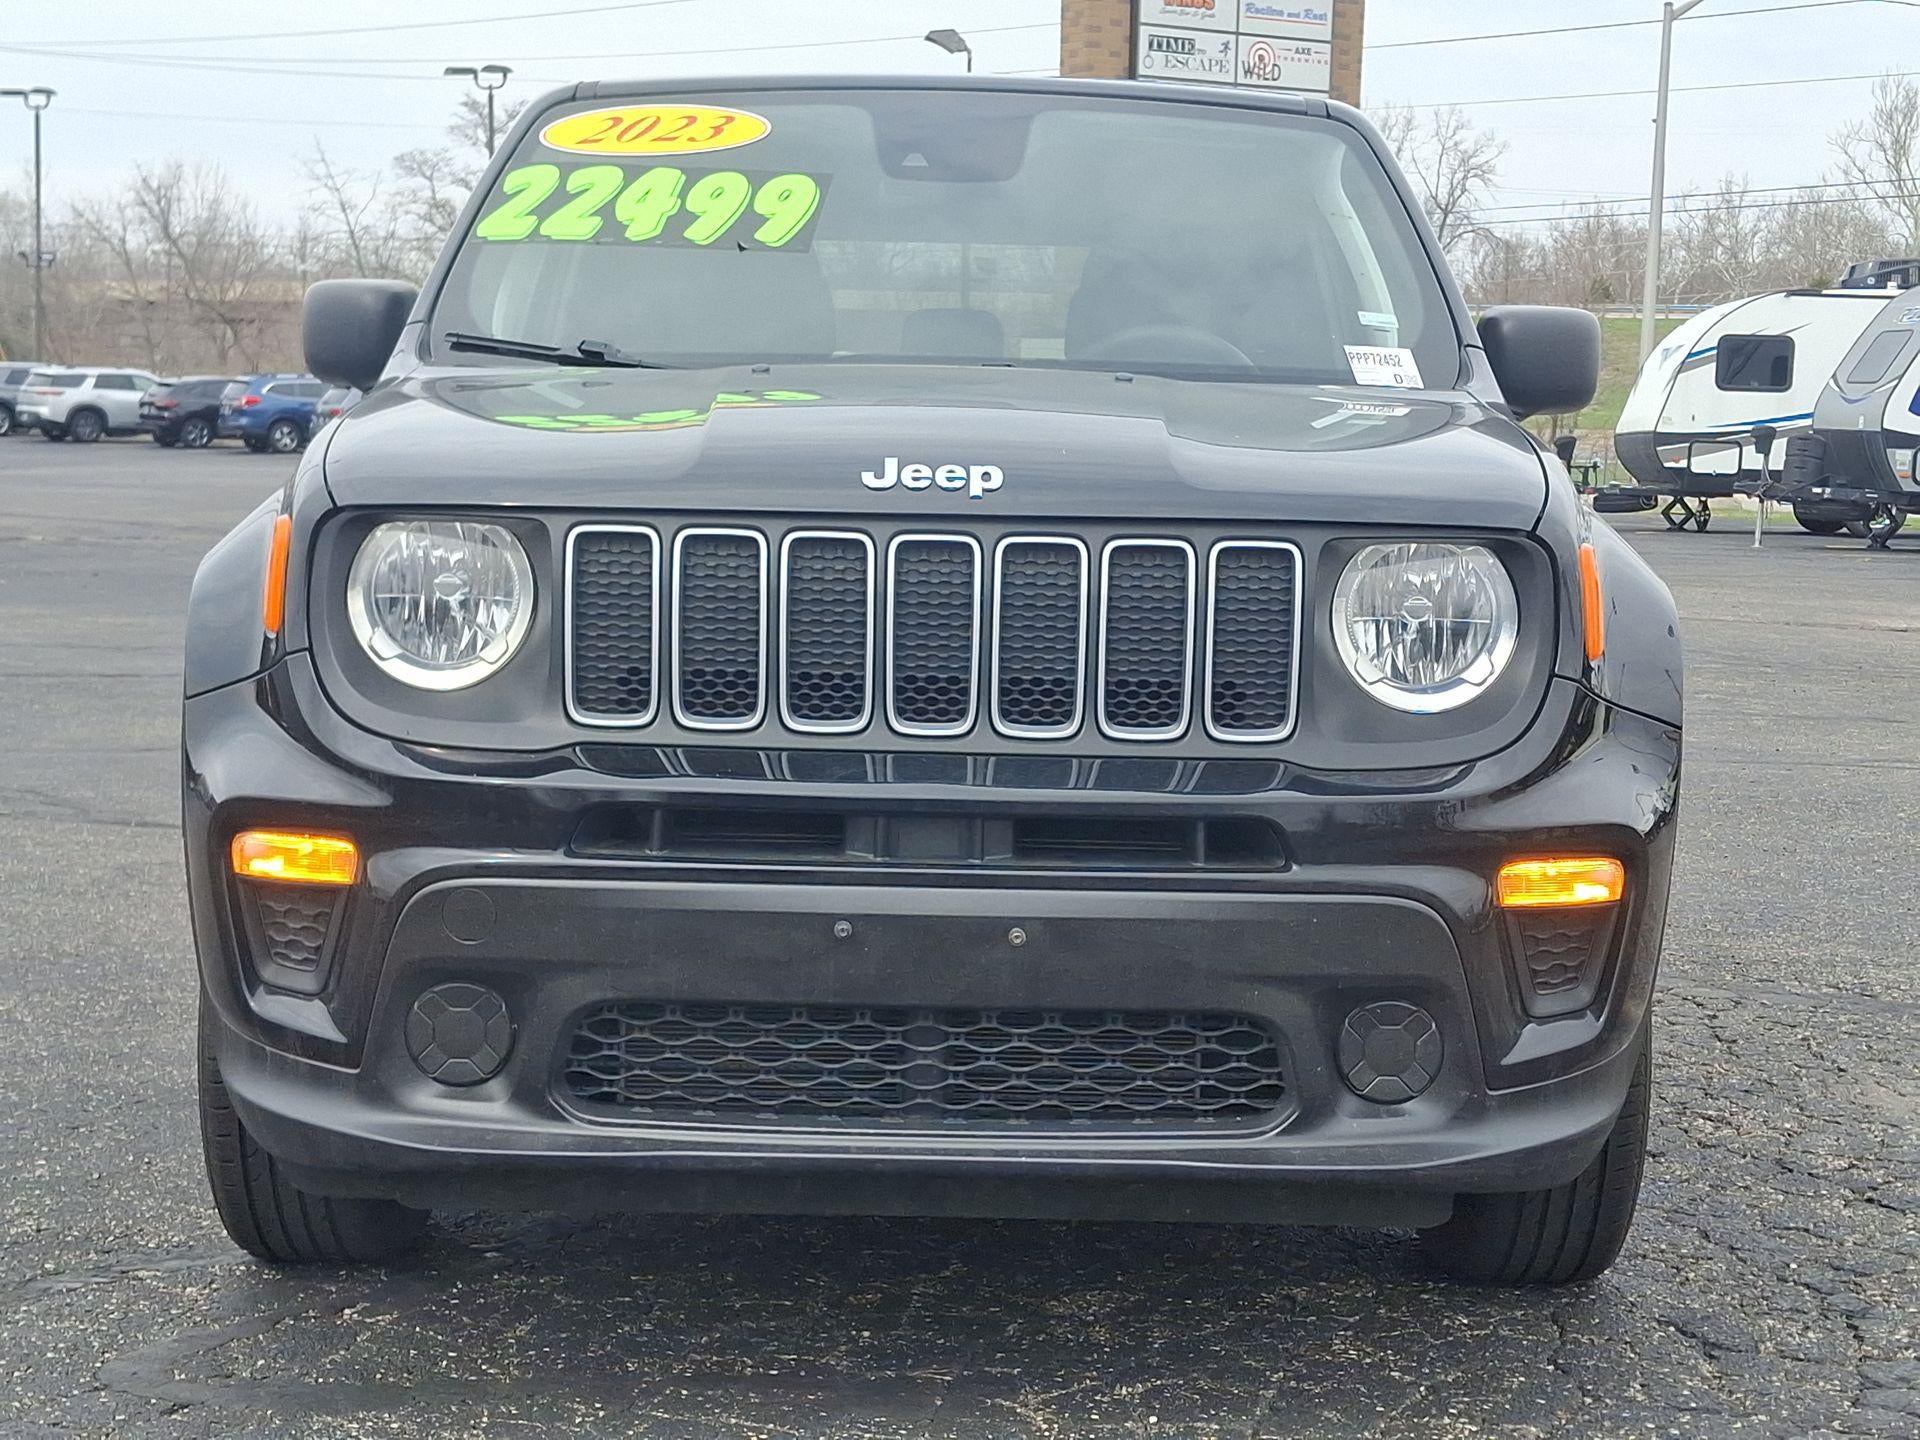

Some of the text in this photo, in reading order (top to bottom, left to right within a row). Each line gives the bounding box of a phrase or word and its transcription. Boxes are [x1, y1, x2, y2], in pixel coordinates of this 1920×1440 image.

[1287, 11, 1301, 19] and
[1150, 35, 1194, 54] TIME
[1294, 47, 1312, 56] AXE
[1164, 54, 1229, 74] ESCAPE
[1242, 60, 1281, 81] WILD
[575, 115, 736, 145] 2023
[476, 164, 820, 248] 22499
[1348, 351, 1403, 368] PPP72452
[1393, 373, 1404, 385] D
[861, 457, 1004, 500] Jeep
